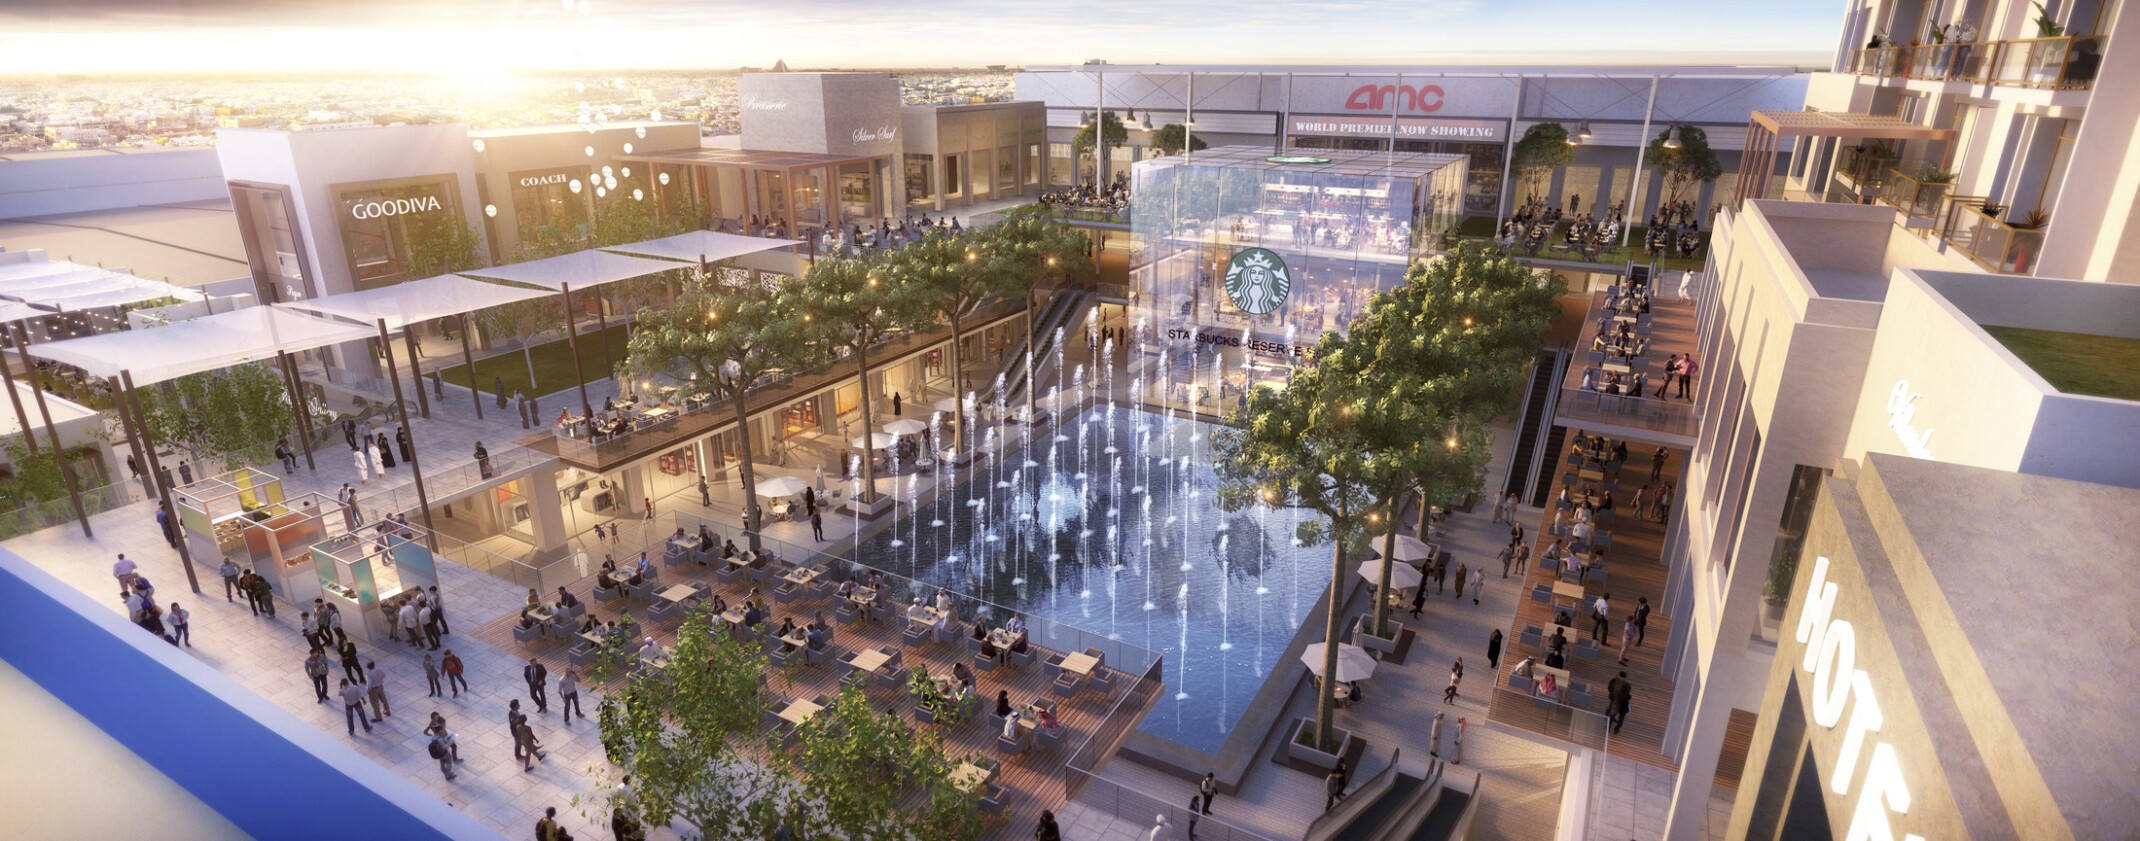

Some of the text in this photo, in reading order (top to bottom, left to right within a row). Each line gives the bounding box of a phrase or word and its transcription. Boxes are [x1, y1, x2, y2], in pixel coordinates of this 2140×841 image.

[1295, 122, 1338, 132] WORLD
[1399, 125, 1428, 135] NOW
[1430, 126, 1494, 137] SHOWING
[520, 173, 568, 187] COACH
[352, 195, 442, 219] GOODIVA
[1168, 329, 1239, 347] STABUCKS
